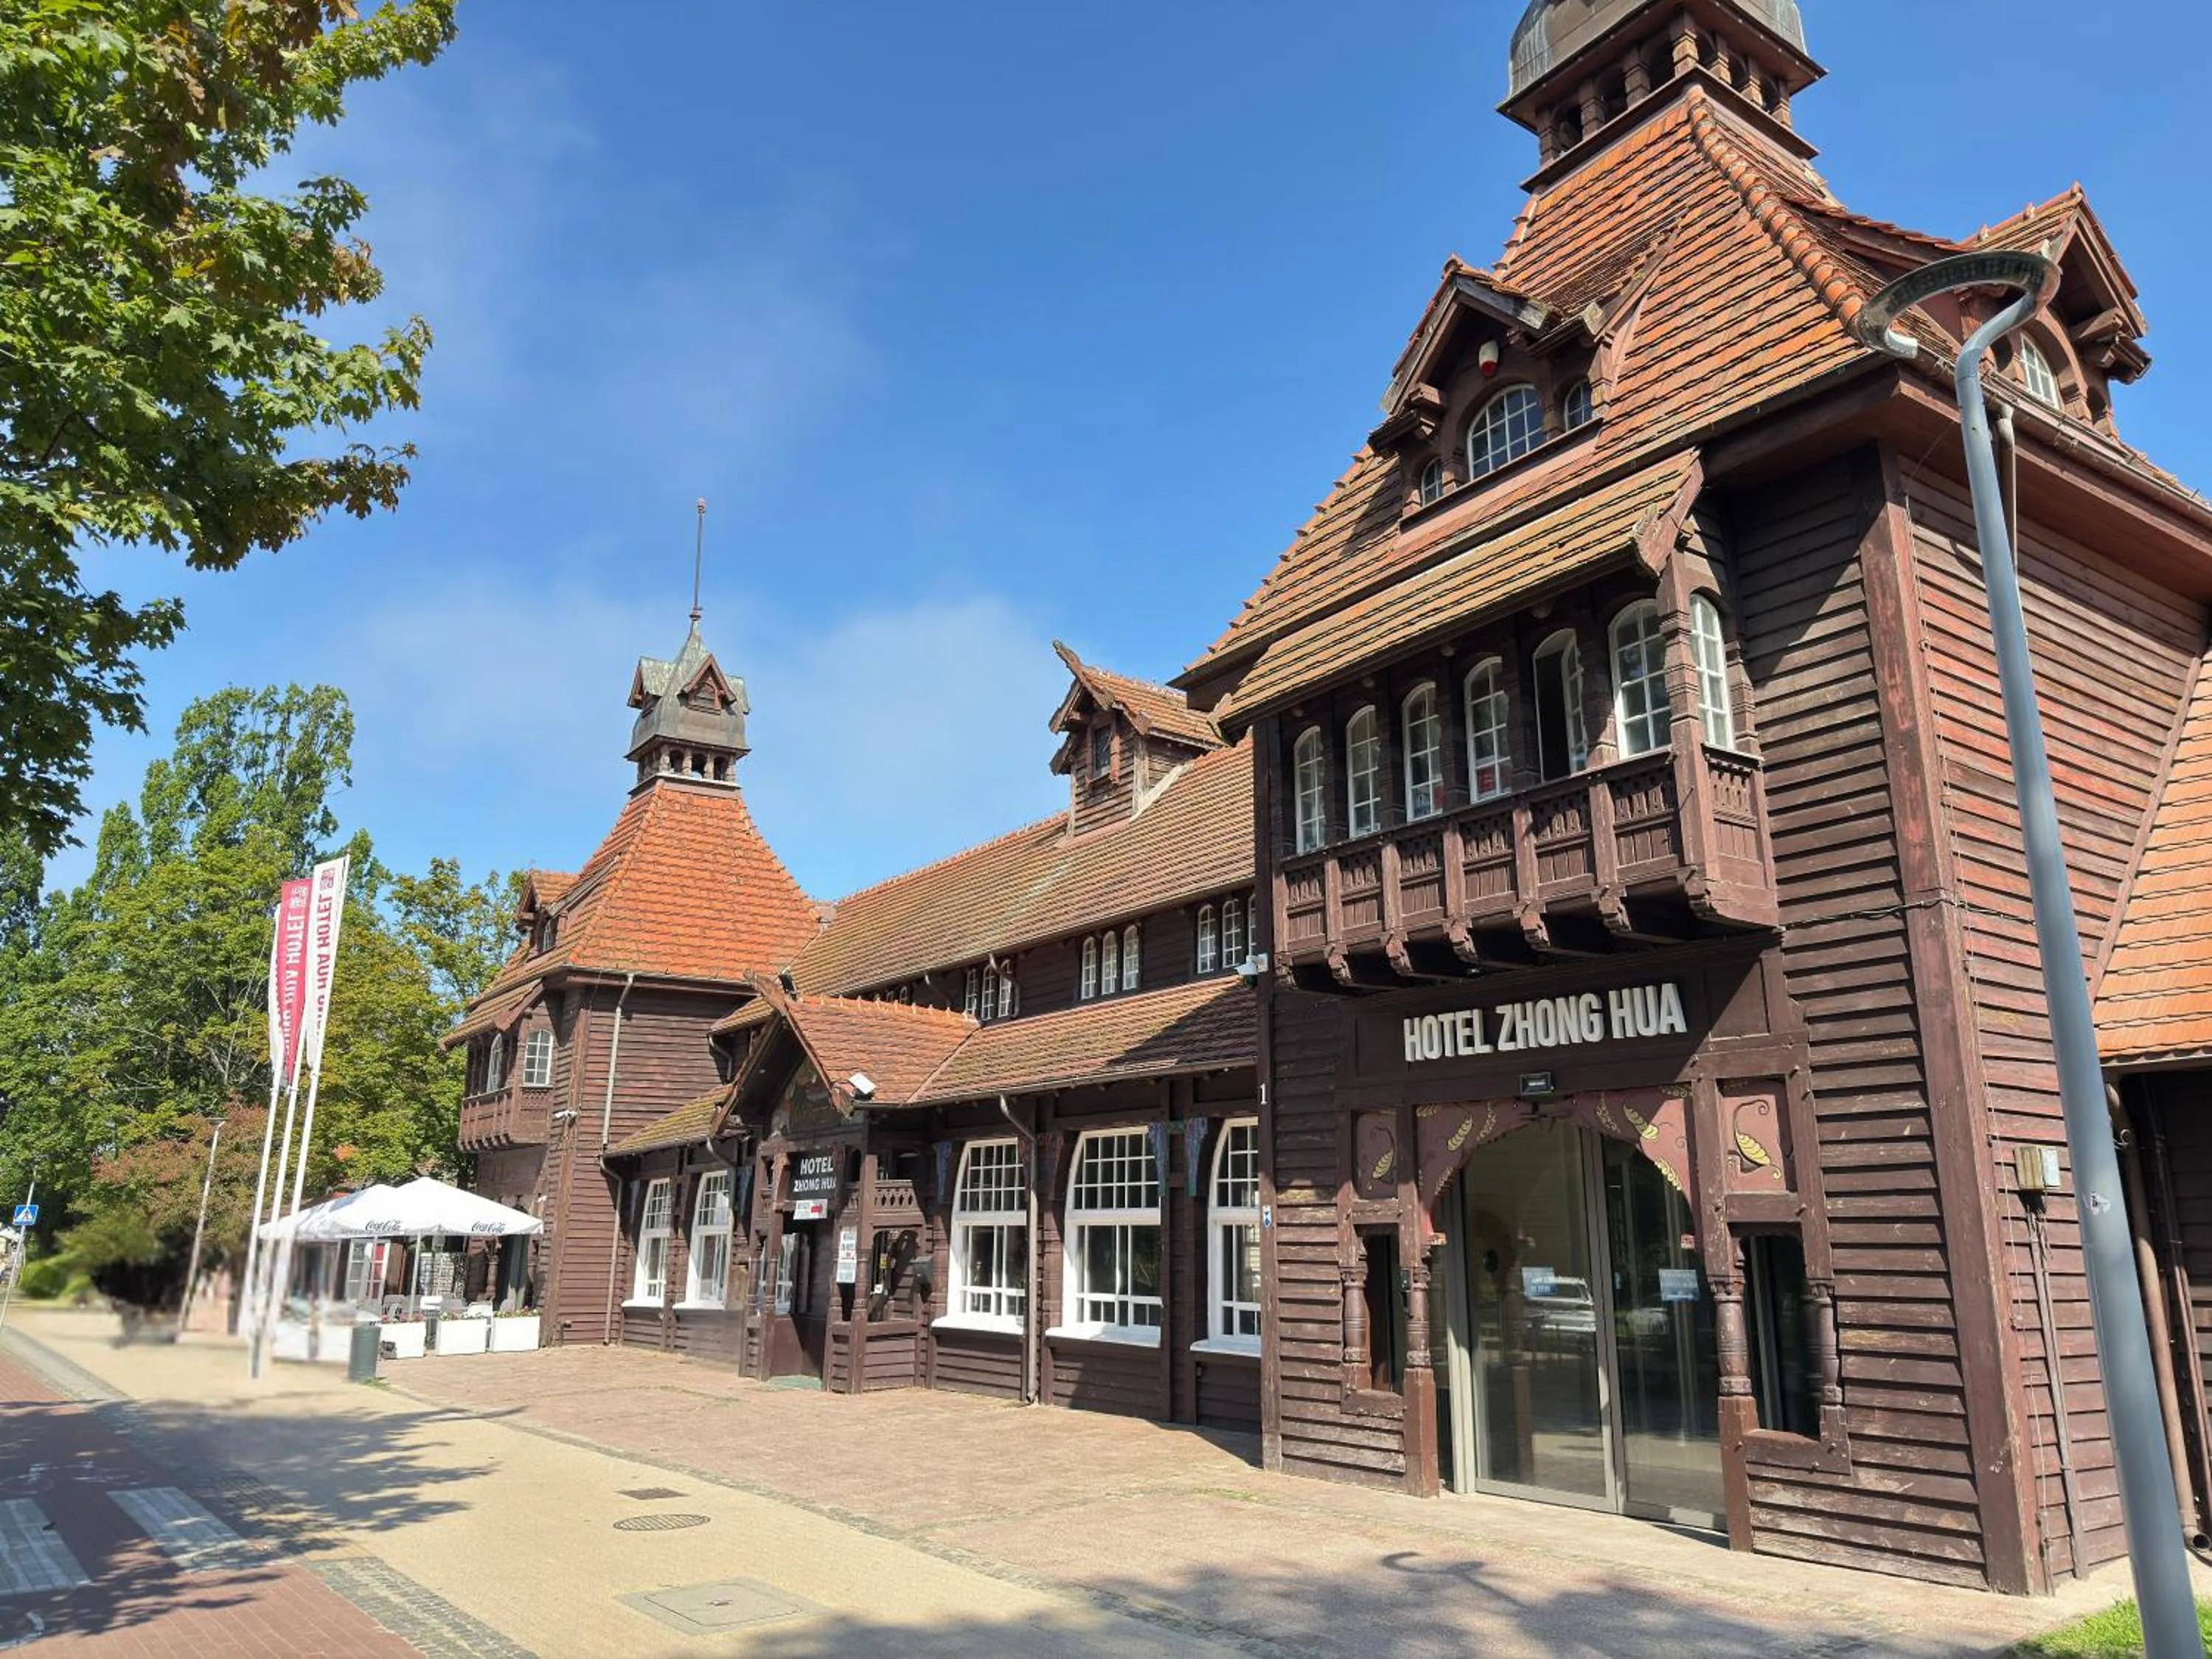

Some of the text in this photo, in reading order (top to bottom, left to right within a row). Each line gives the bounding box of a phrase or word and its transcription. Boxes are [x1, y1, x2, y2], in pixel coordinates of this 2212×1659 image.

[1403, 983, 1687, 1062] HOTEL ZHONG HUA
[800, 1156, 834, 1176] HOTEL
[793, 1178, 820, 1192] ZHONG
